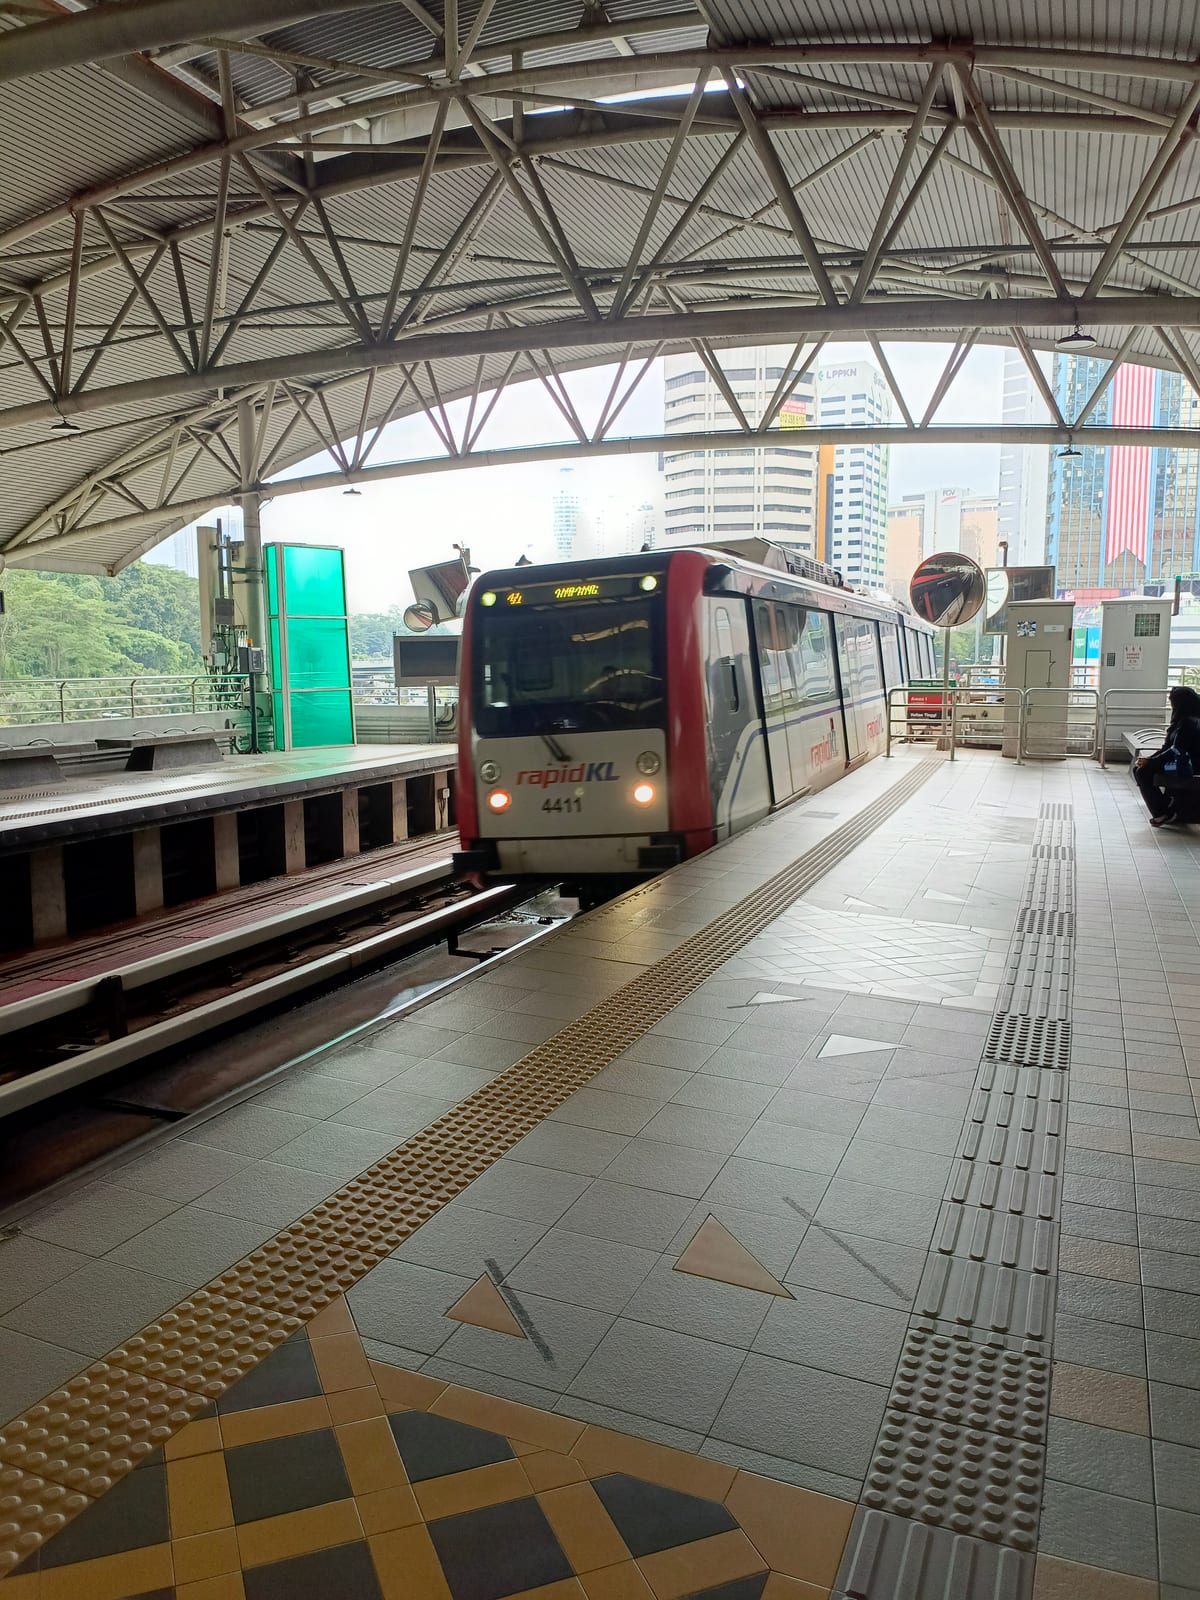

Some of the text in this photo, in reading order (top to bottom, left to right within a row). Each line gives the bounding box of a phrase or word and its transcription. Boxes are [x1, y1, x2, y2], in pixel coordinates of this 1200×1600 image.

[826, 368, 857, 379] LPPKN
[516, 762, 620, 789] rapidKL
[542, 797, 582, 813] 4411
